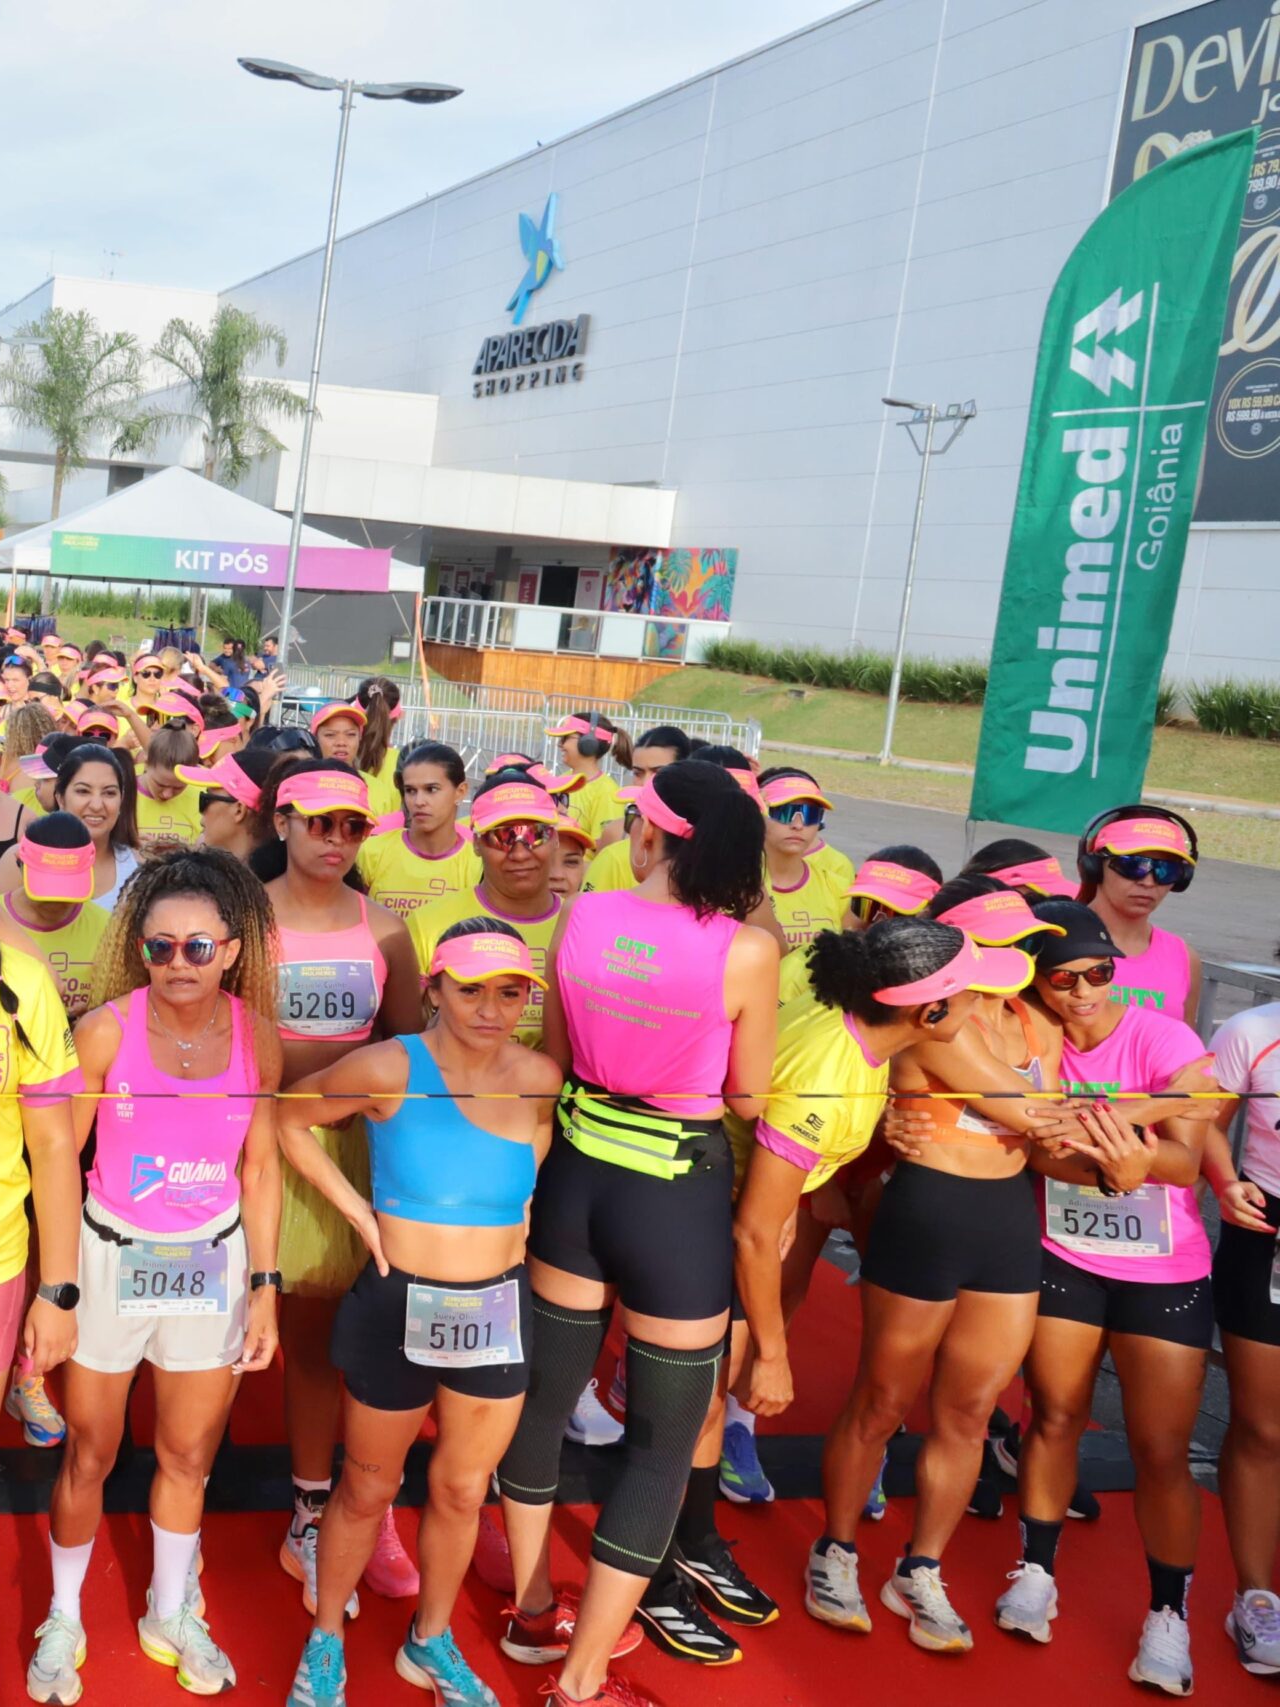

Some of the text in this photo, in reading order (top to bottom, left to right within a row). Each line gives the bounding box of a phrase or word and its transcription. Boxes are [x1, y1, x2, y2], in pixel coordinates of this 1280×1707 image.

[472, 313, 590, 375] APARECIDA
[473, 362, 584, 399] SHOPPING
[1136, 423, 1182, 571] Goiânia
[175, 547, 269, 575] KIT PÓS
[1023, 423, 1130, 776] Unimed
[614, 936, 658, 960] CITY
[289, 991, 355, 1019] 5269
[1064, 1208, 1141, 1241] 5250
[133, 1269, 206, 1297] 5048
[429, 1321, 492, 1350] 5101
